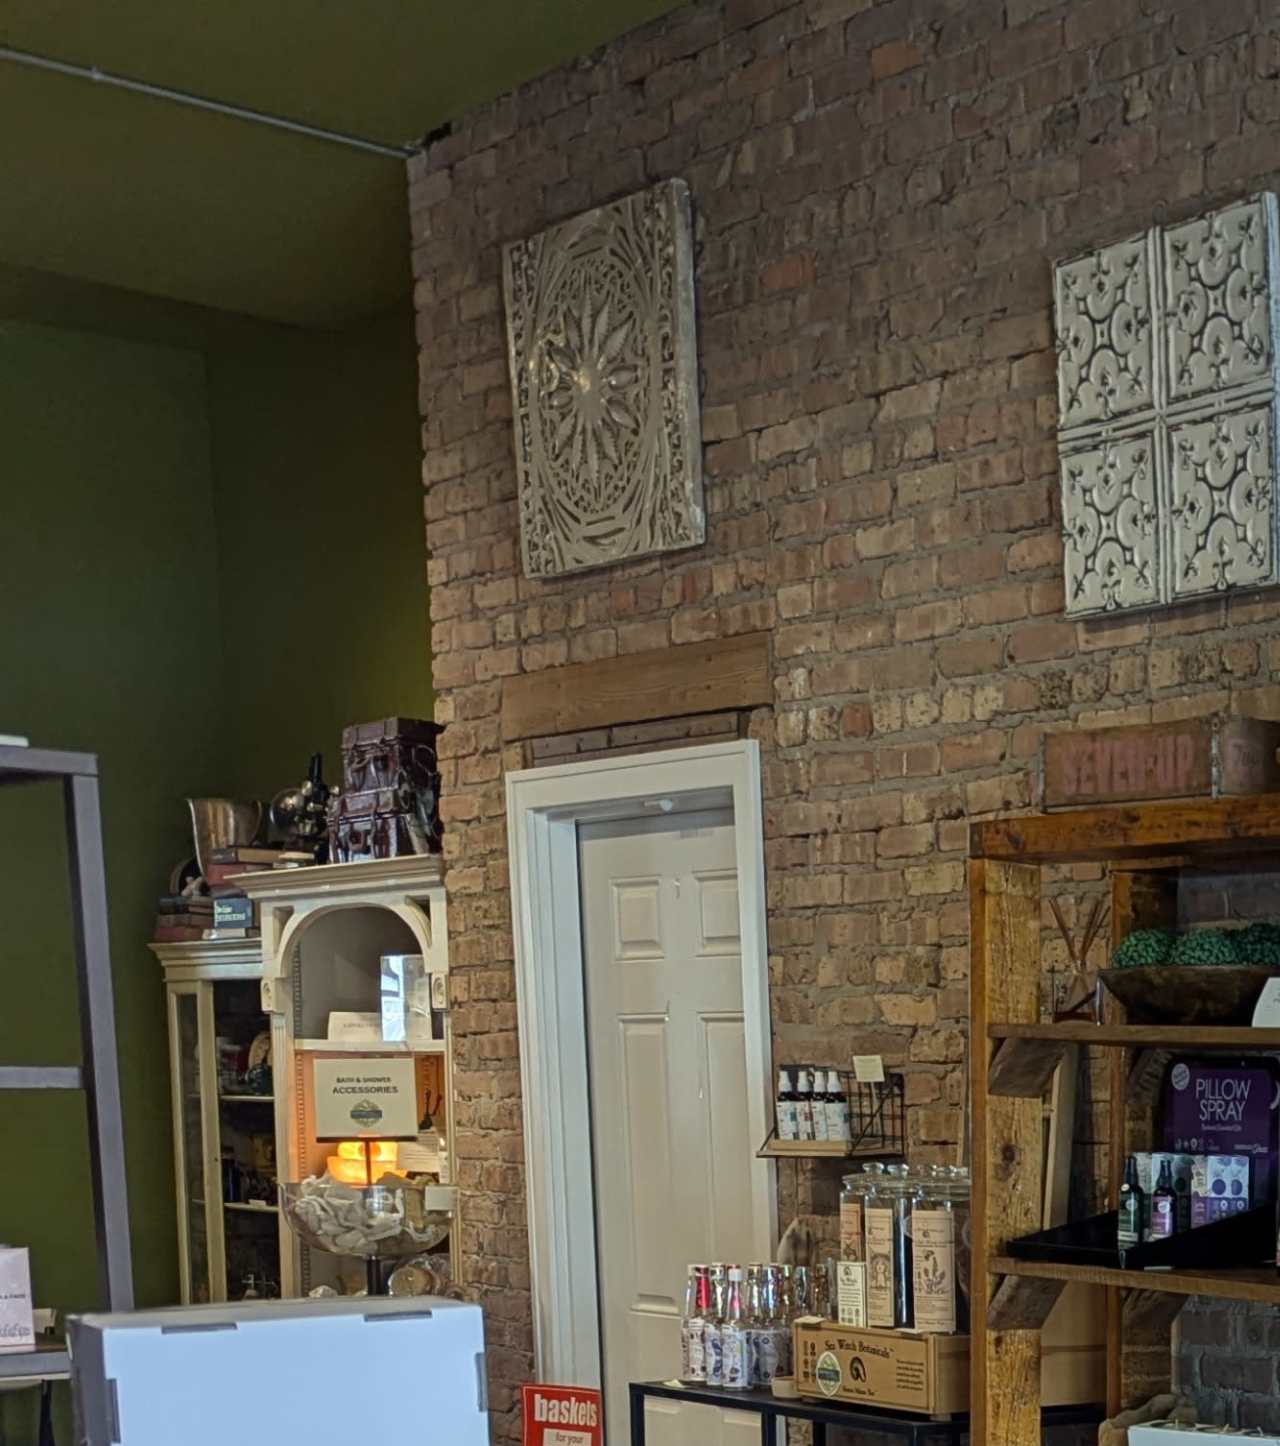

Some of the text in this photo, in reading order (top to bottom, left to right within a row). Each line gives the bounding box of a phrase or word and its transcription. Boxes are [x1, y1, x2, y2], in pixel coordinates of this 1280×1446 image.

[332, 1086, 399, 1095] ACCESSORIES
[1195, 1079, 1252, 1100] PILLOW
[1199, 1100, 1246, 1121] SPRAY
[533, 1393, 599, 1428] baskets
[567, 1433, 584, 1446] your
